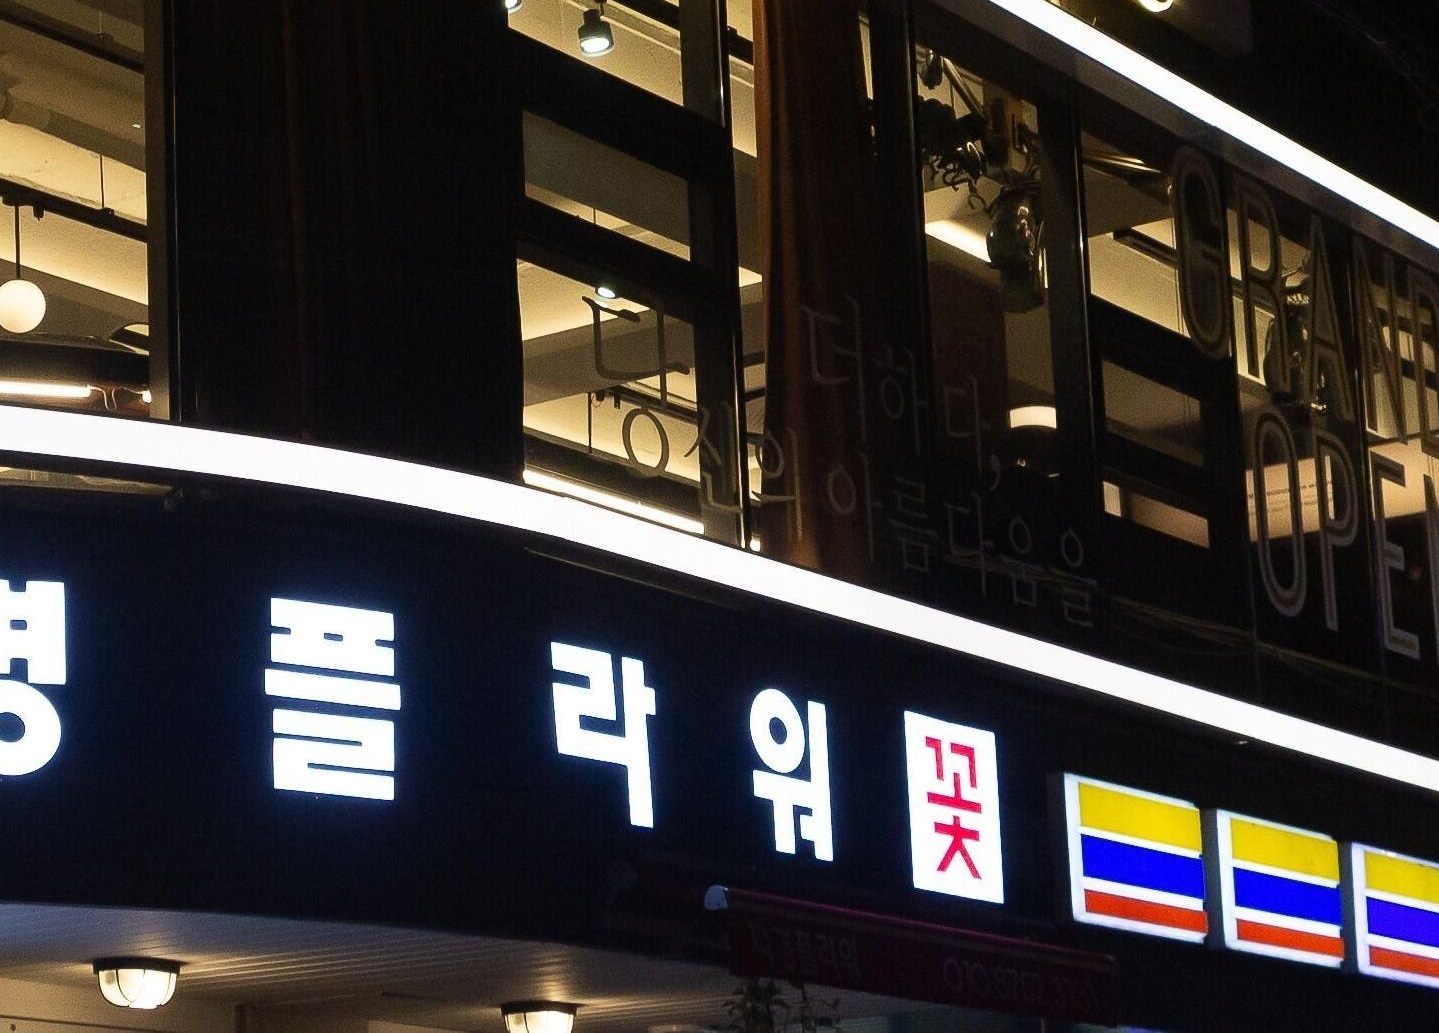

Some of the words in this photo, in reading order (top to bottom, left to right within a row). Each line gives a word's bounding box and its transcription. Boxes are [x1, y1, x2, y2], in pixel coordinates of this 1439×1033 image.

[582, 295, 803, 543] 당신의
[826, 452, 1096, 630] 아름다움을
[1253, 410, 1439, 667] OPE
[924, 735, 982, 881] 꽃
